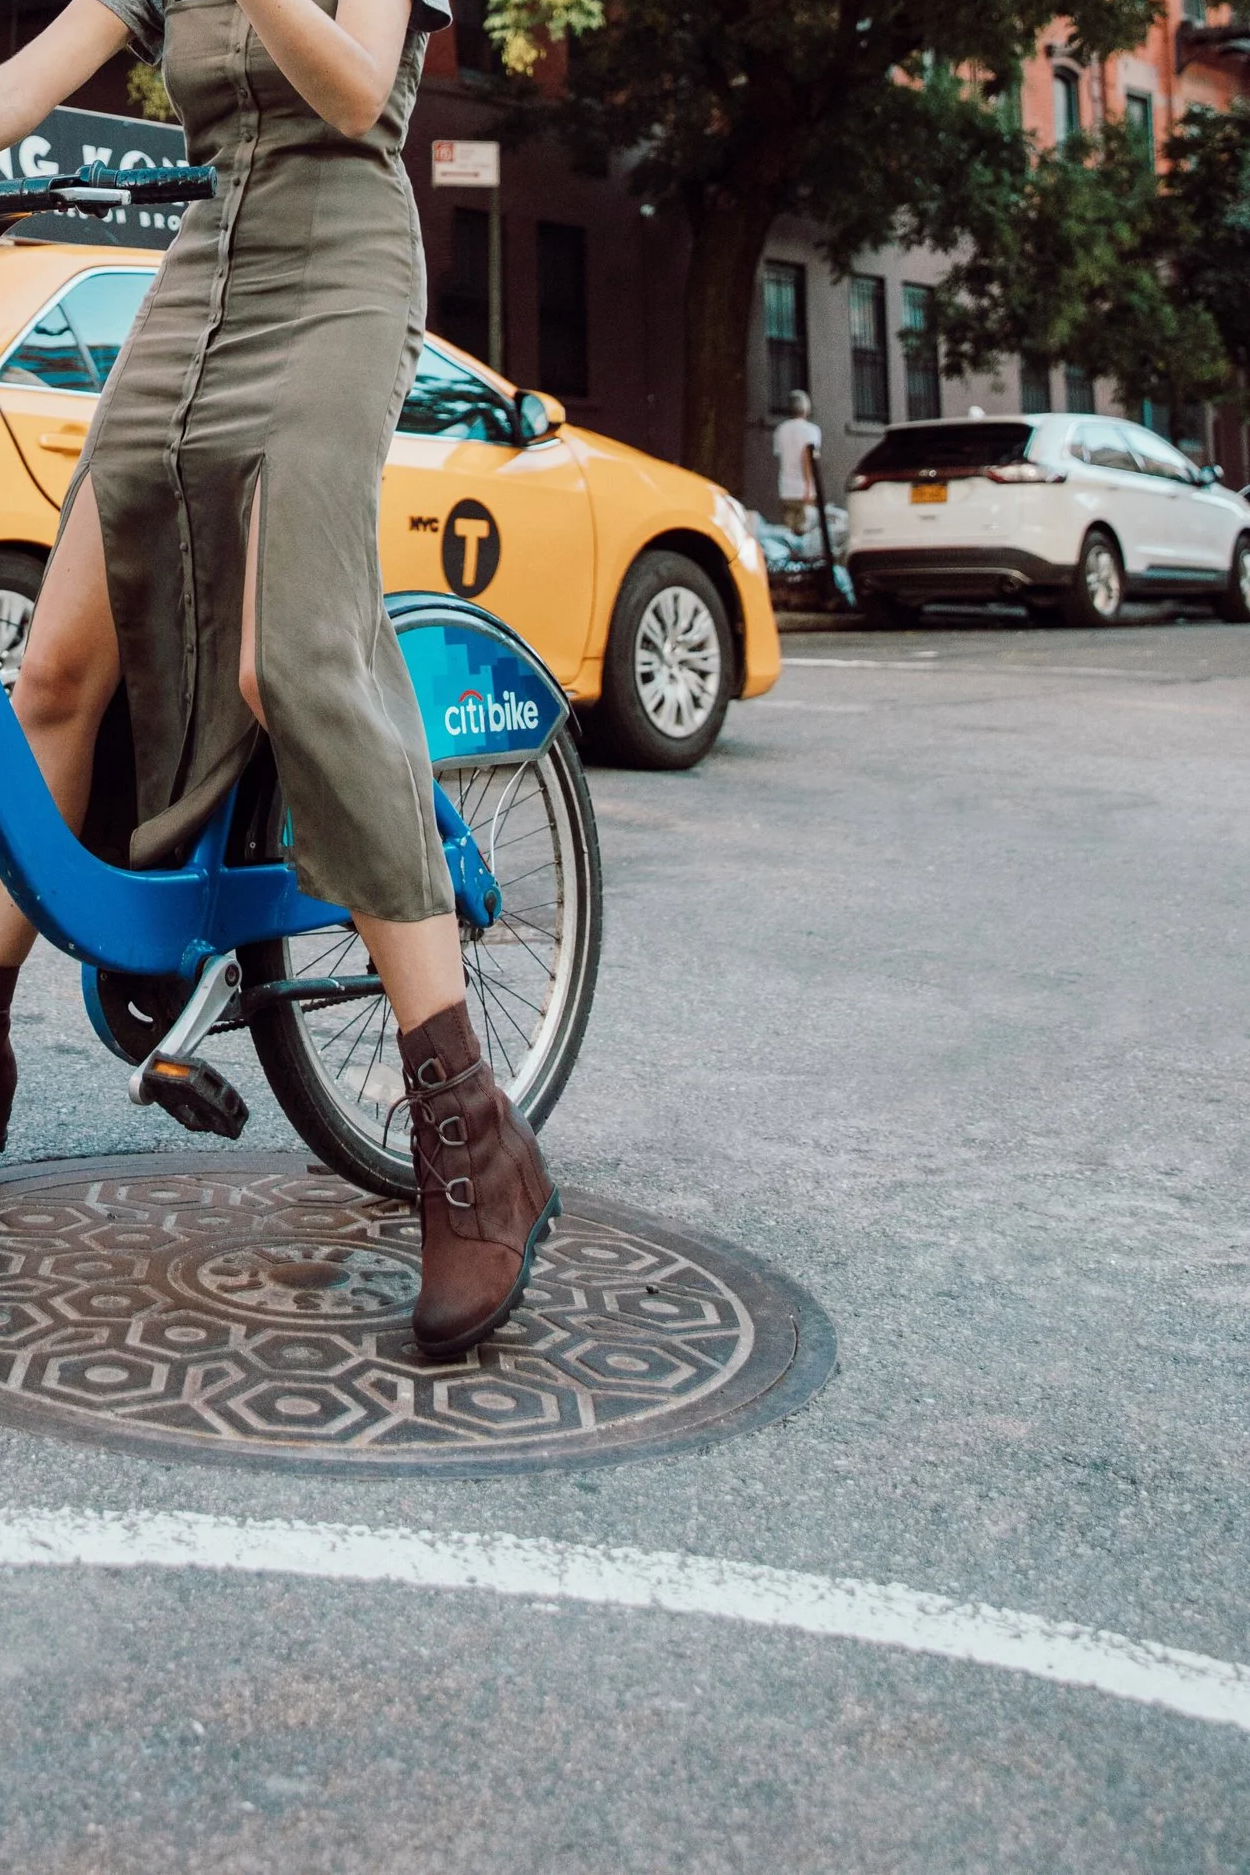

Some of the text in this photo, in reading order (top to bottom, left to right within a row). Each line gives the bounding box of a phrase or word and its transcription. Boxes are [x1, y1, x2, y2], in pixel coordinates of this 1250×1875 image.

[409, 516, 490, 587] NYC T
[445, 689, 539, 736] citi bike
